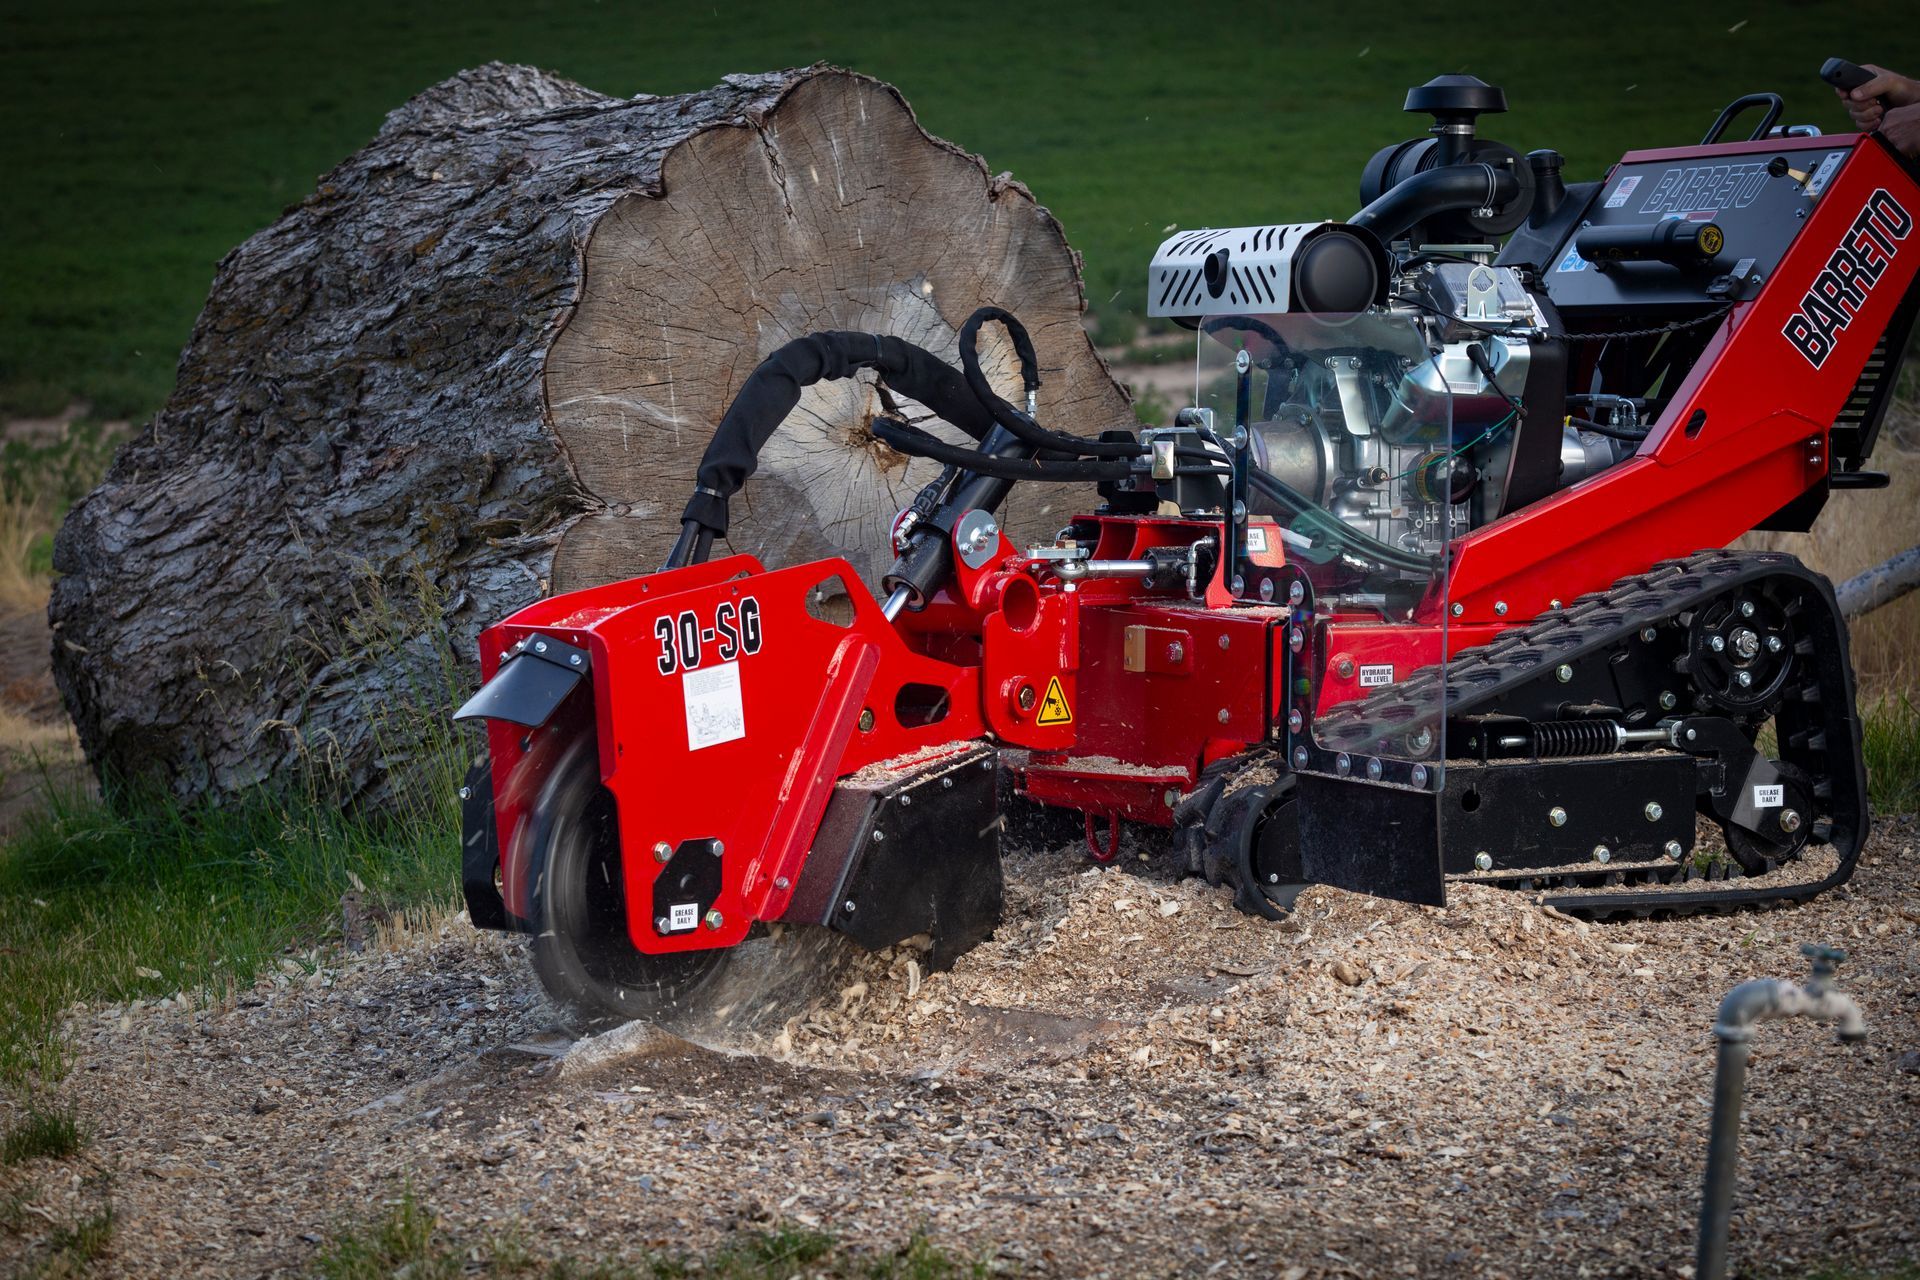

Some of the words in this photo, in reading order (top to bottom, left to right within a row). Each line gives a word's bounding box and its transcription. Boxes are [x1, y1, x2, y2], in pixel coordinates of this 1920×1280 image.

[1638, 157, 1772, 214] BARRETO
[1781, 188, 1914, 370] BARRETO
[654, 596, 762, 676] 30-SG
[675, 908, 694, 917] GREASE
[677, 917, 691, 925] DAILY
